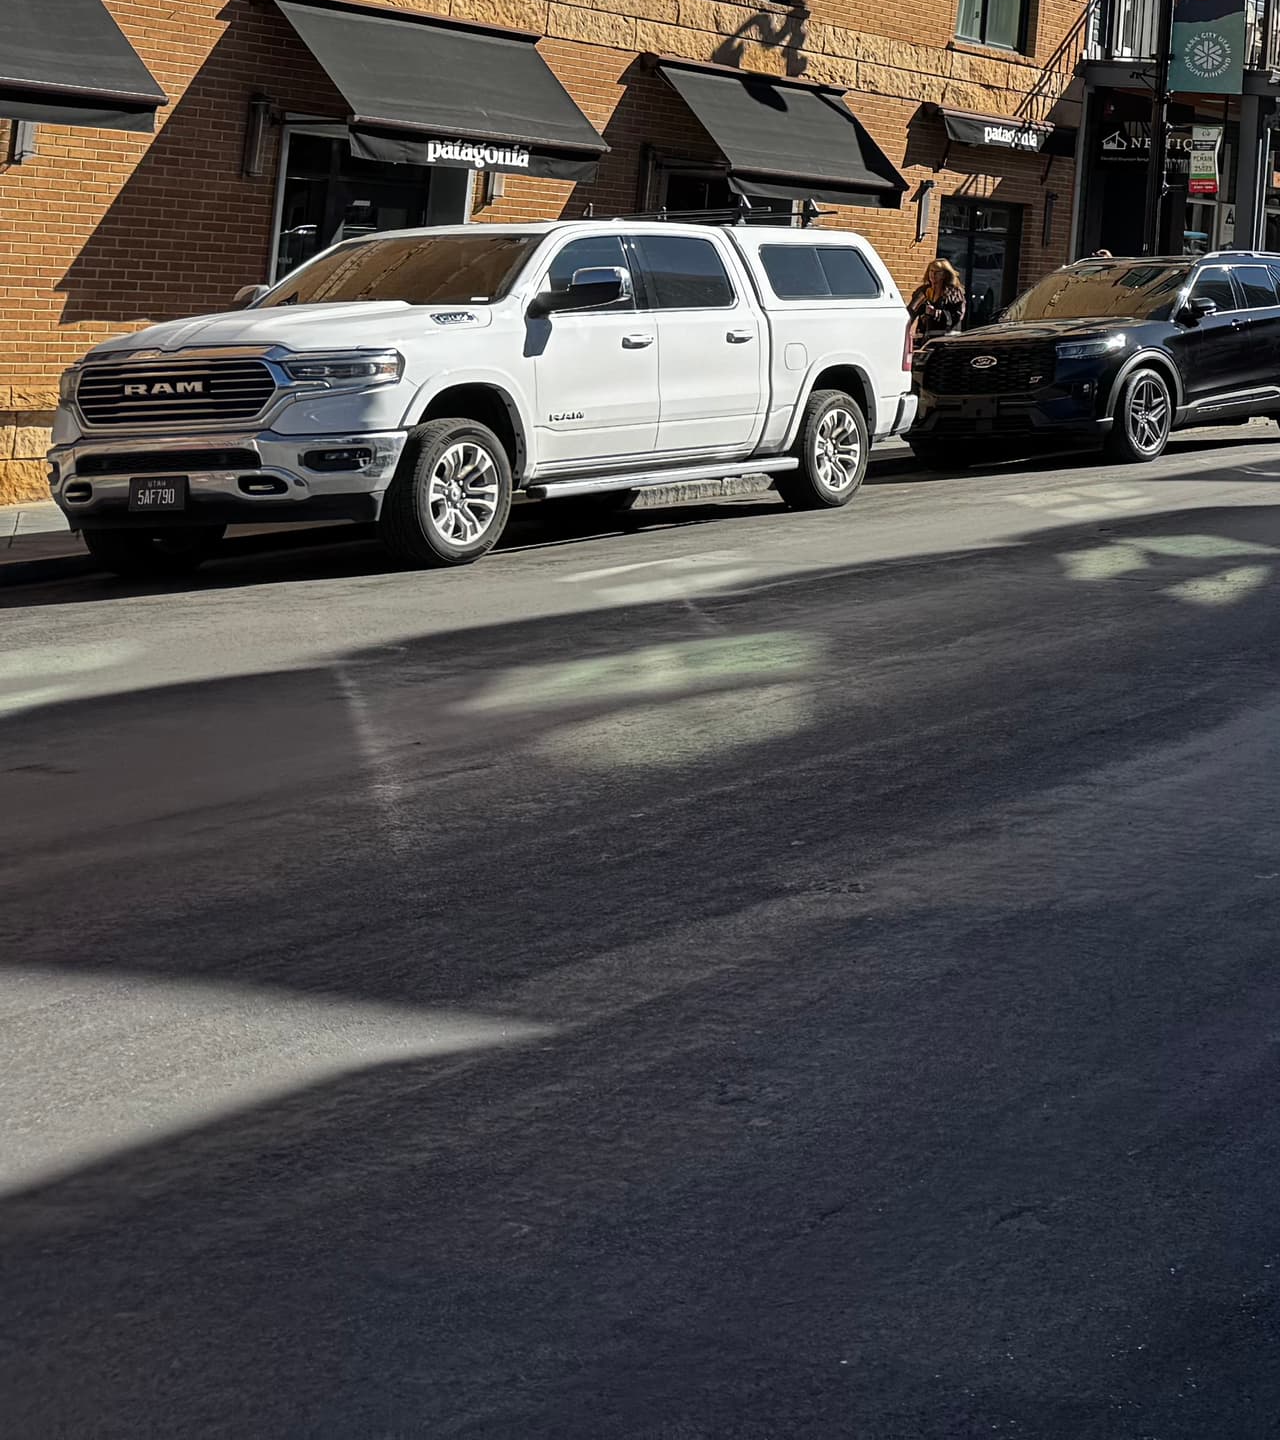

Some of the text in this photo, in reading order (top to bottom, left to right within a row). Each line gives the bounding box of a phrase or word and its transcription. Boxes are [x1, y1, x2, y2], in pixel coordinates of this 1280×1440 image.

[427, 140, 530, 168] patagonia
[124, 381, 203, 396] RAM
[137, 488, 175, 505] 5AF790
